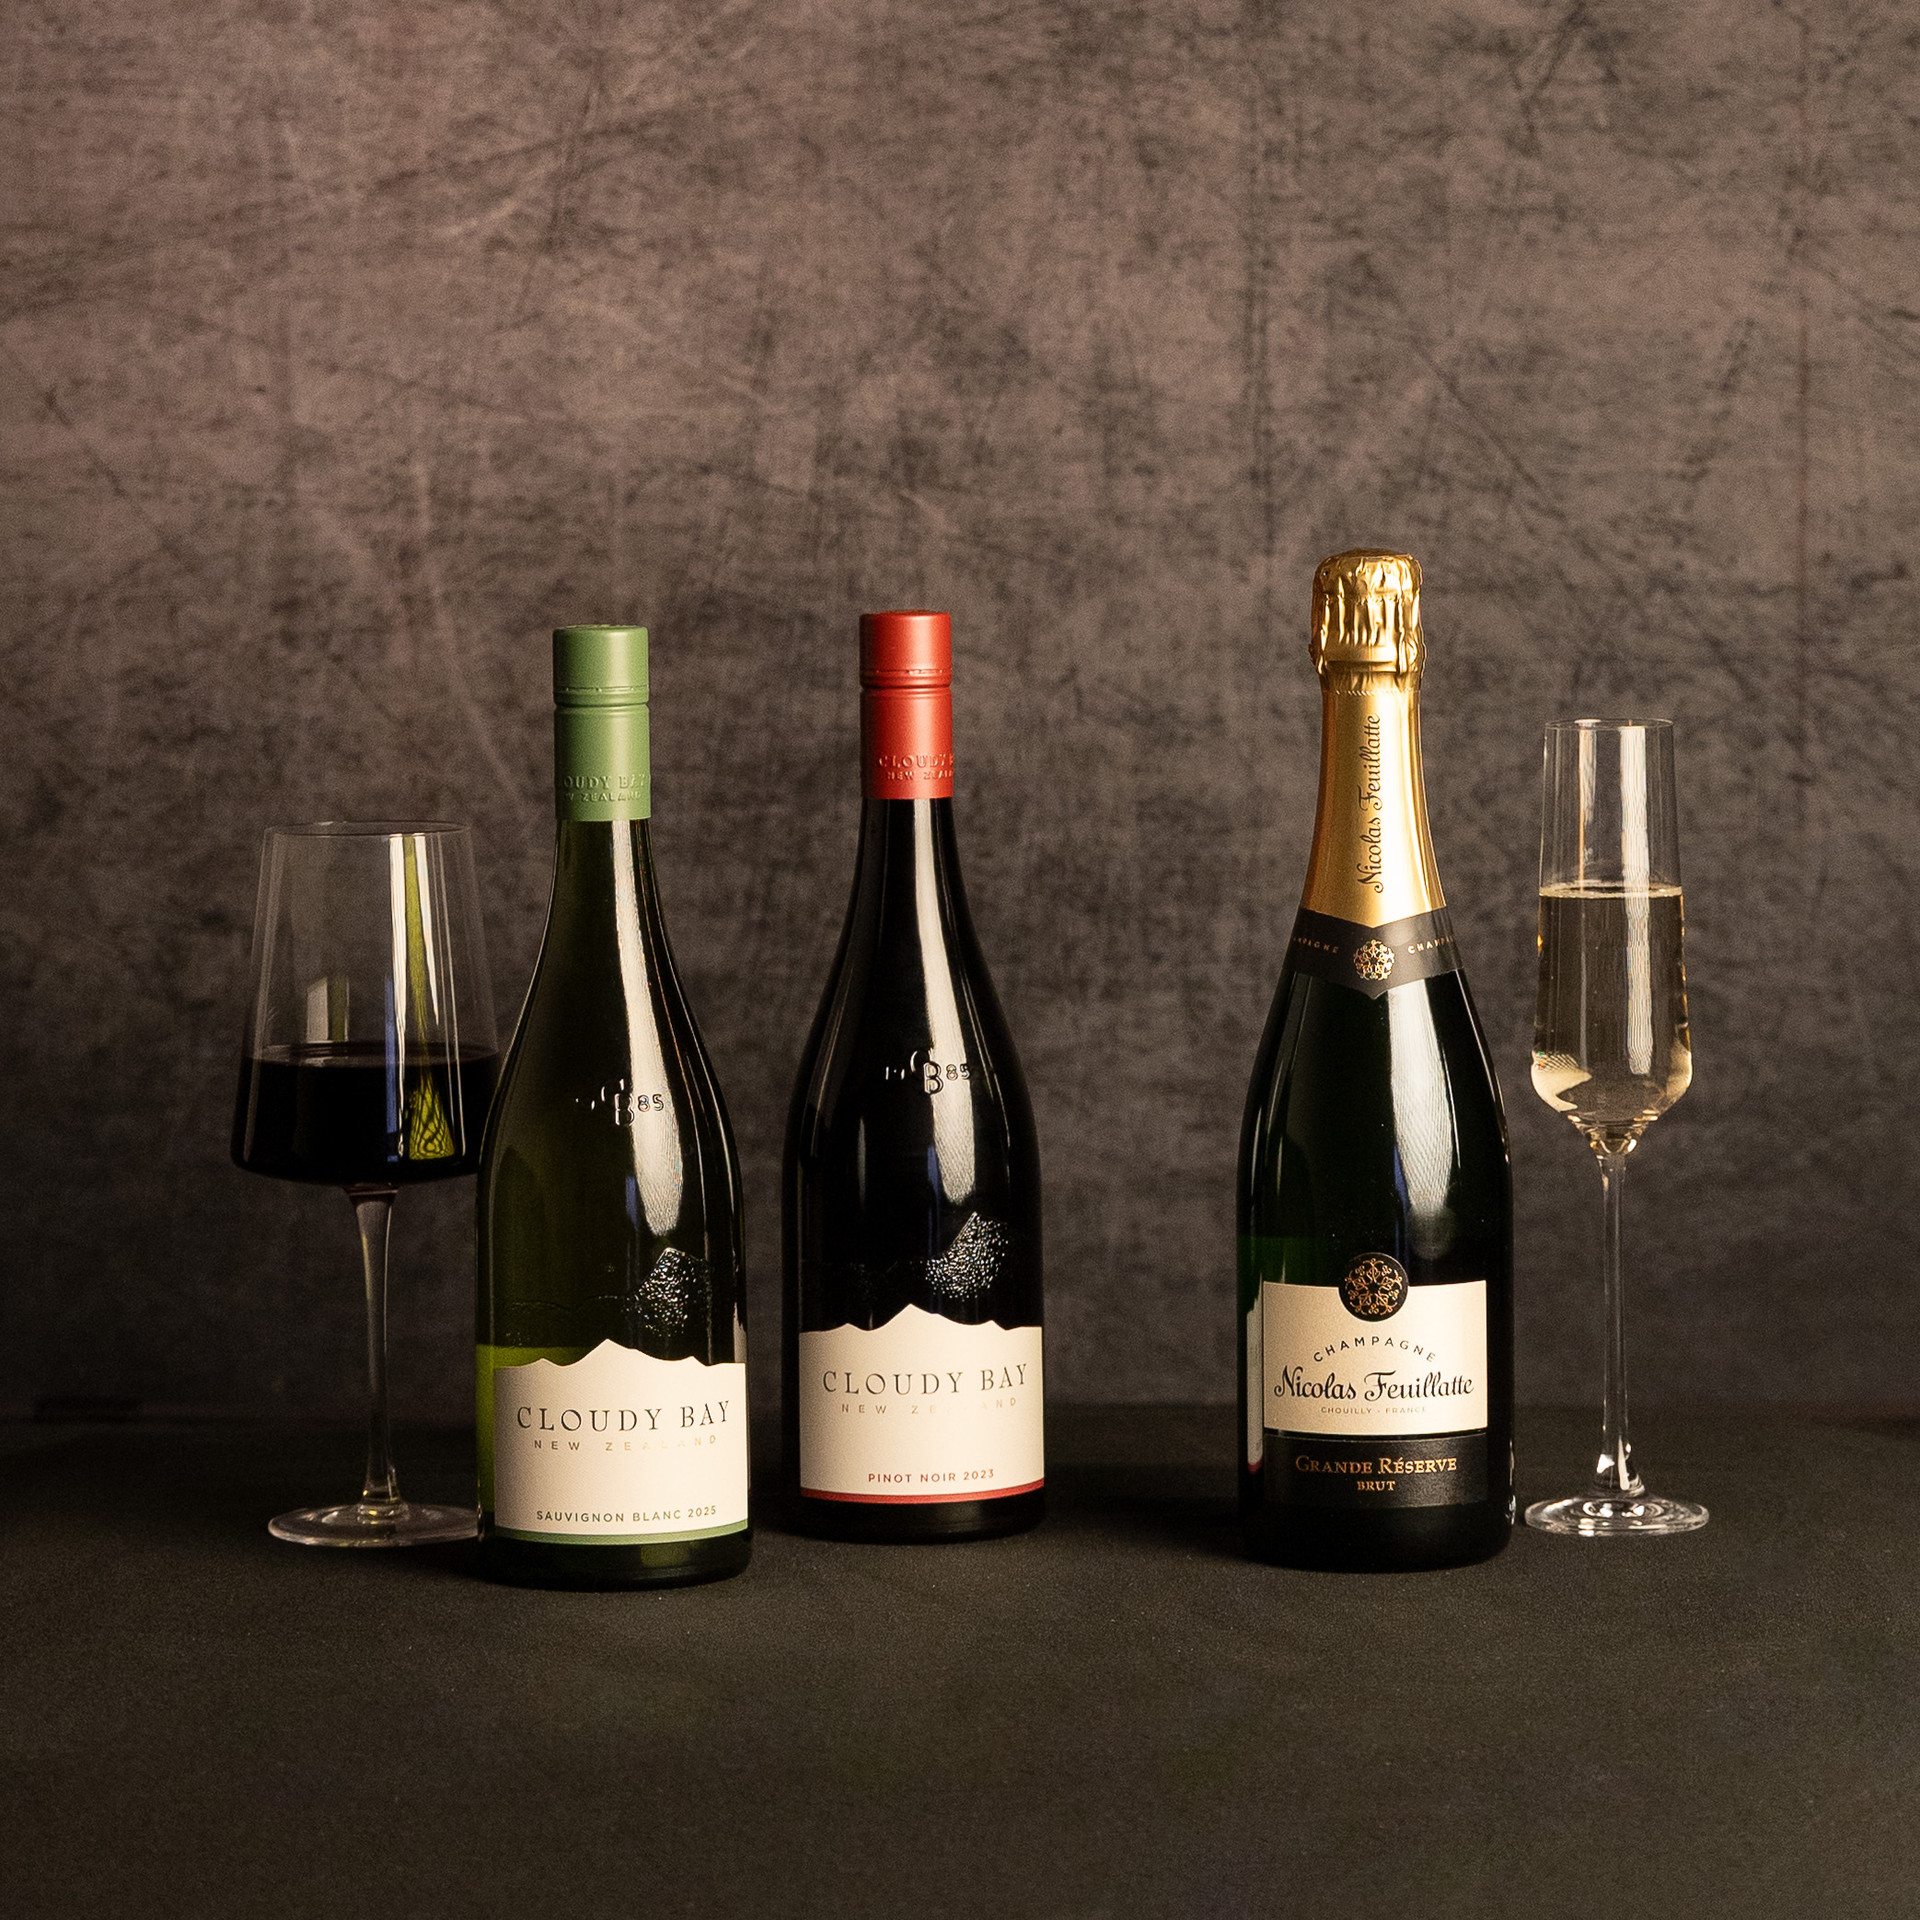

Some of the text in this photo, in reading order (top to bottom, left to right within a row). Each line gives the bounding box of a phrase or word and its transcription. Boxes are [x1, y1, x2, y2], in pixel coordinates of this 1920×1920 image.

[563, 775, 610, 789] OUDY
[1356, 713, 1384, 894] Nicolas Feuillatte
[1313, 1336, 1437, 1363] CHAMPAGNE
[823, 1363, 1028, 1395] CLOUDY BAY
[1274, 1365, 1475, 1402] Nicolas Feuillatte
[517, 1400, 730, 1432] CLOUDY BAY
[841, 1404, 888, 1415] NEW
[1385, 1406, 1427, 1414] FRANCE
[534, 1440, 582, 1451] NEW
[868, 1468, 995, 1484] PINOT NOIR 2023
[1357, 1480, 1396, 1491] BRUT
[536, 1505, 717, 1523] SAUVIGNON BLANC 2025
